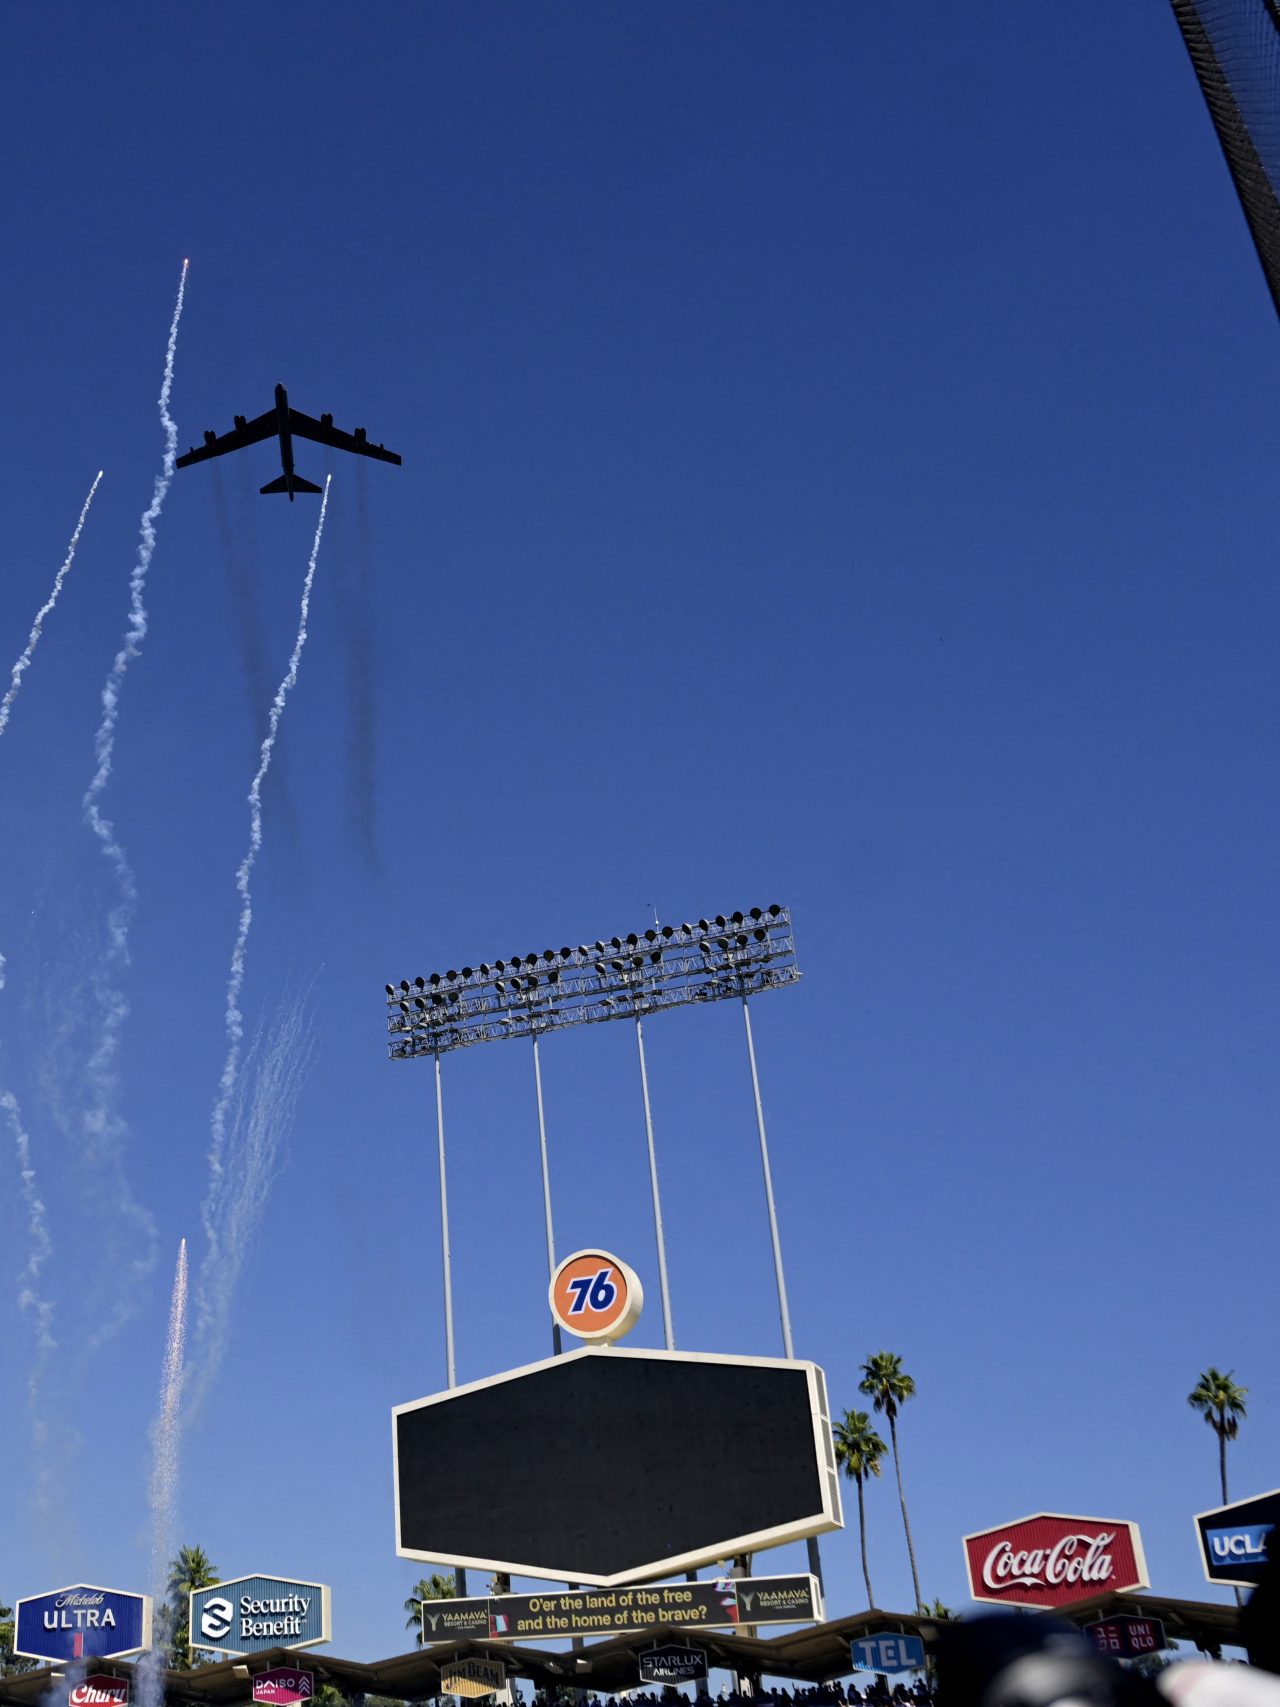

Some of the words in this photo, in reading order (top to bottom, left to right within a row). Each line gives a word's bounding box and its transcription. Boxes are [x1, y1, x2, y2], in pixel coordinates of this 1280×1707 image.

[566, 1268, 614, 1315] 76
[983, 1531, 1117, 1589] Coca-Cola
[55, 1592, 105, 1608] Michelob
[240, 1593, 311, 1616] Security
[560, 1597, 583, 1610] the
[586, 1593, 616, 1608] land
[619, 1592, 634, 1606] of
[636, 1591, 660, 1605] the
[663, 1589, 693, 1603] free
[43, 1608, 116, 1629] ULTRA
[240, 1616, 302, 1637] Benefit
[517, 1616, 543, 1630] and
[546, 1615, 569, 1629] the
[571, 1613, 611, 1628] home
[614, 1610, 629, 1624] of
[632, 1610, 656, 1624] the
[658, 1604, 708, 1622] brave?
[1128, 1623, 1151, 1636] UNI
[858, 1639, 917, 1668] TEL
[1131, 1637, 1154, 1649] QLO
[642, 1655, 703, 1668] STARLUX
[653, 1666, 695, 1677] AIRLINES
[71, 1684, 126, 1704] Churu
[255, 1679, 296, 1689] DAISO
